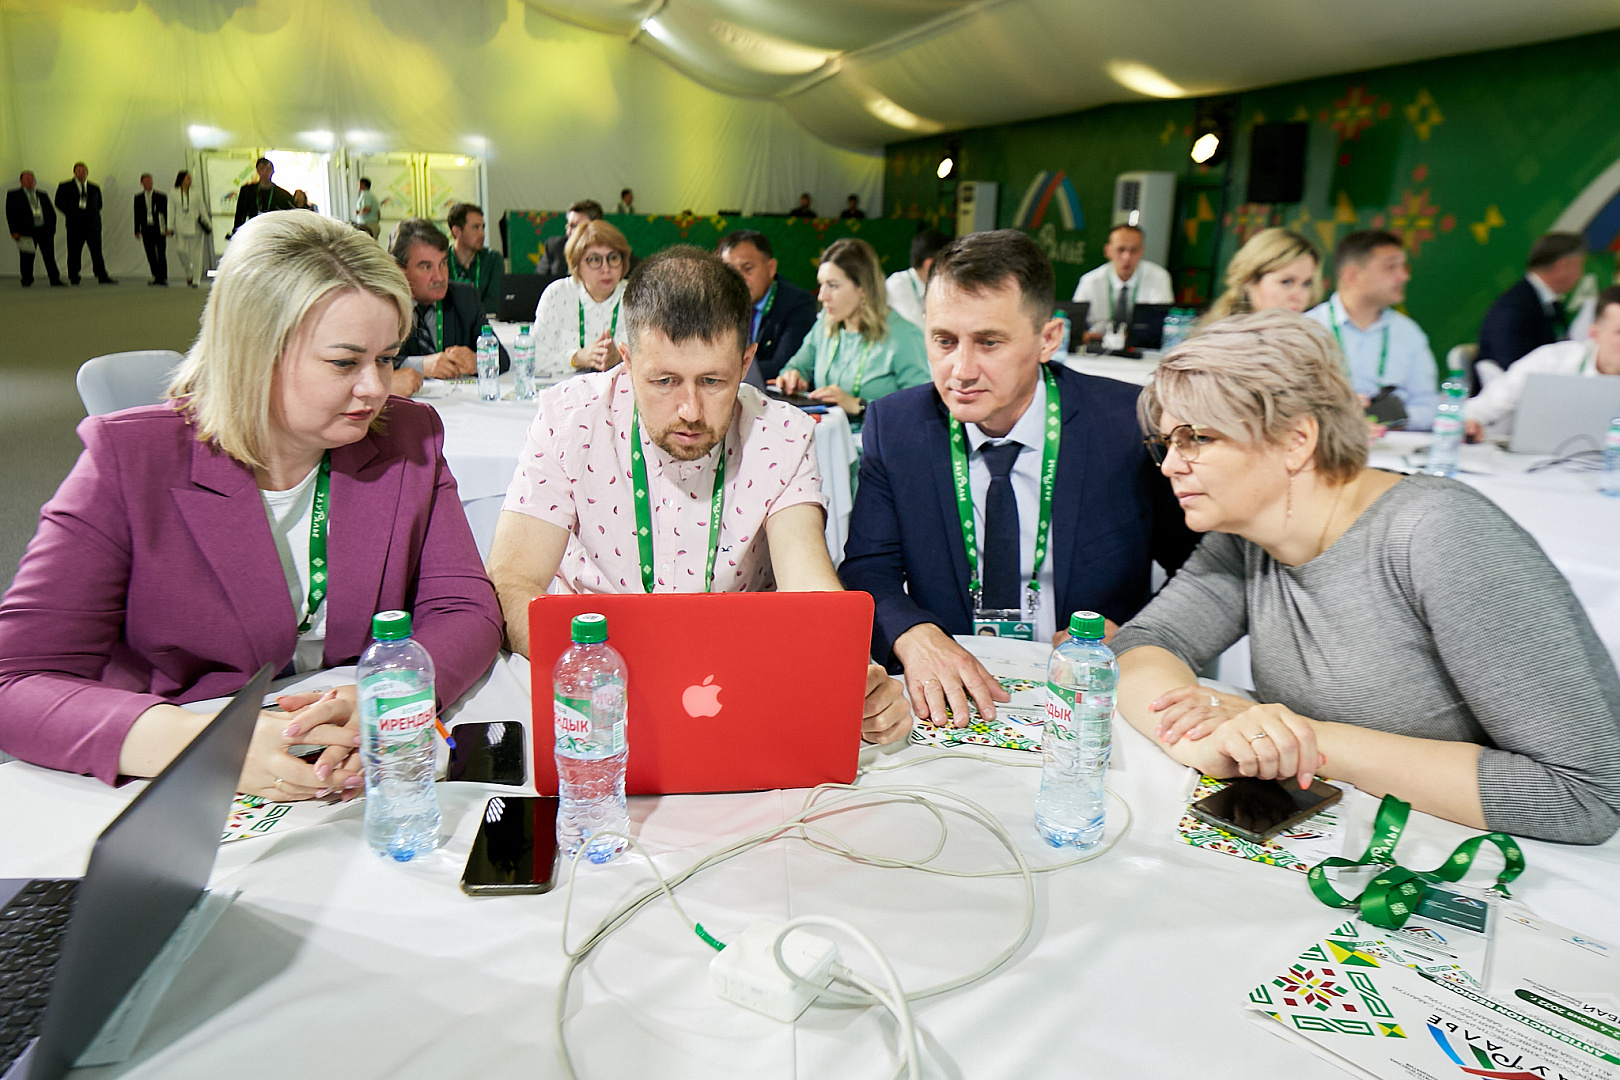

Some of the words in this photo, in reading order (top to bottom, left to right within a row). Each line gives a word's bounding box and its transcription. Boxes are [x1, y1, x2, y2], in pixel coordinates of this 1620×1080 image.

[954, 460, 967, 502] ЗАУРАЛЬЕ
[1043, 459, 1056, 501] ЗАУРАЛЬЕ
[312, 492, 325, 538] ЗАУРАЛЬЕ
[713, 489, 723, 529] ЗАУРАЛЬЕ
[1459, 1005, 1503, 1027] SABANTUY
[1538, 1000, 1566, 1015] 2022
[1567, 1012, 1599, 1028] июня
[1496, 1006, 1605, 1057] ANTISANCTION
[1504, 1026, 1557, 1052] INVESTMENT
